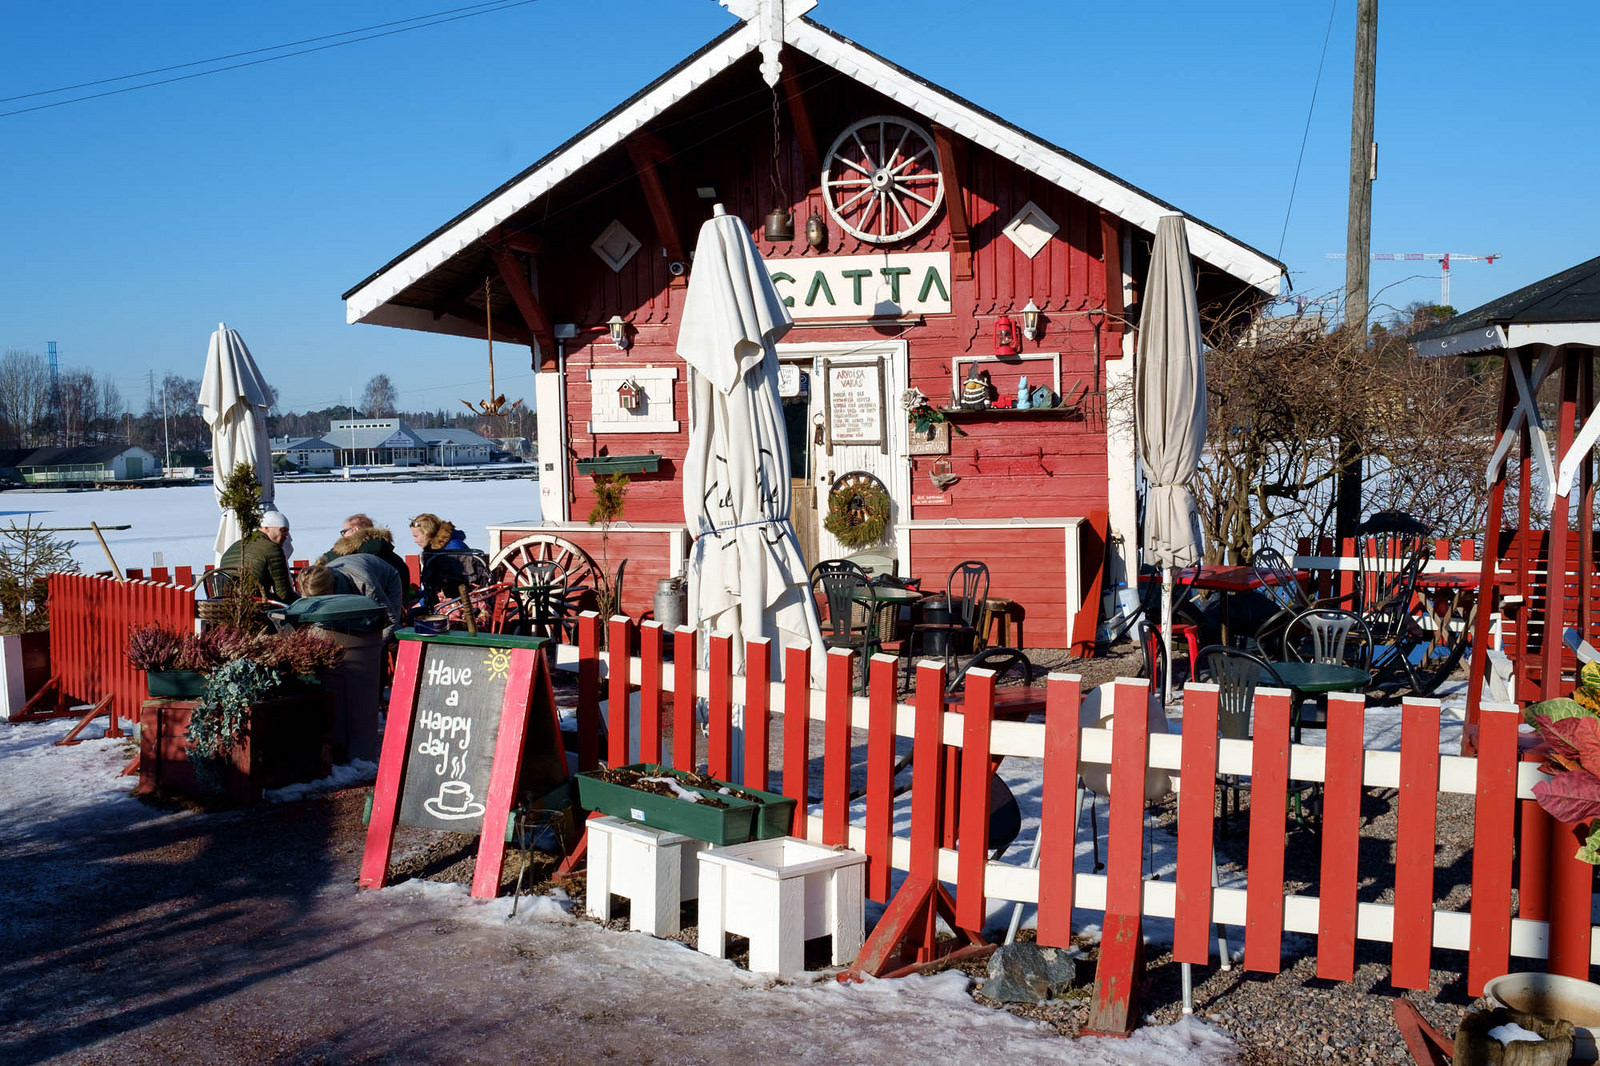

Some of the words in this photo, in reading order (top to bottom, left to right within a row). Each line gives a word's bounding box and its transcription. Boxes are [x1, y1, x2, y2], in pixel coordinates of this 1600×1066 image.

[428, 659, 472, 686] Have
[445, 689, 459, 707] a
[419, 709, 472, 750] Happy
[418, 731, 450, 776] day
